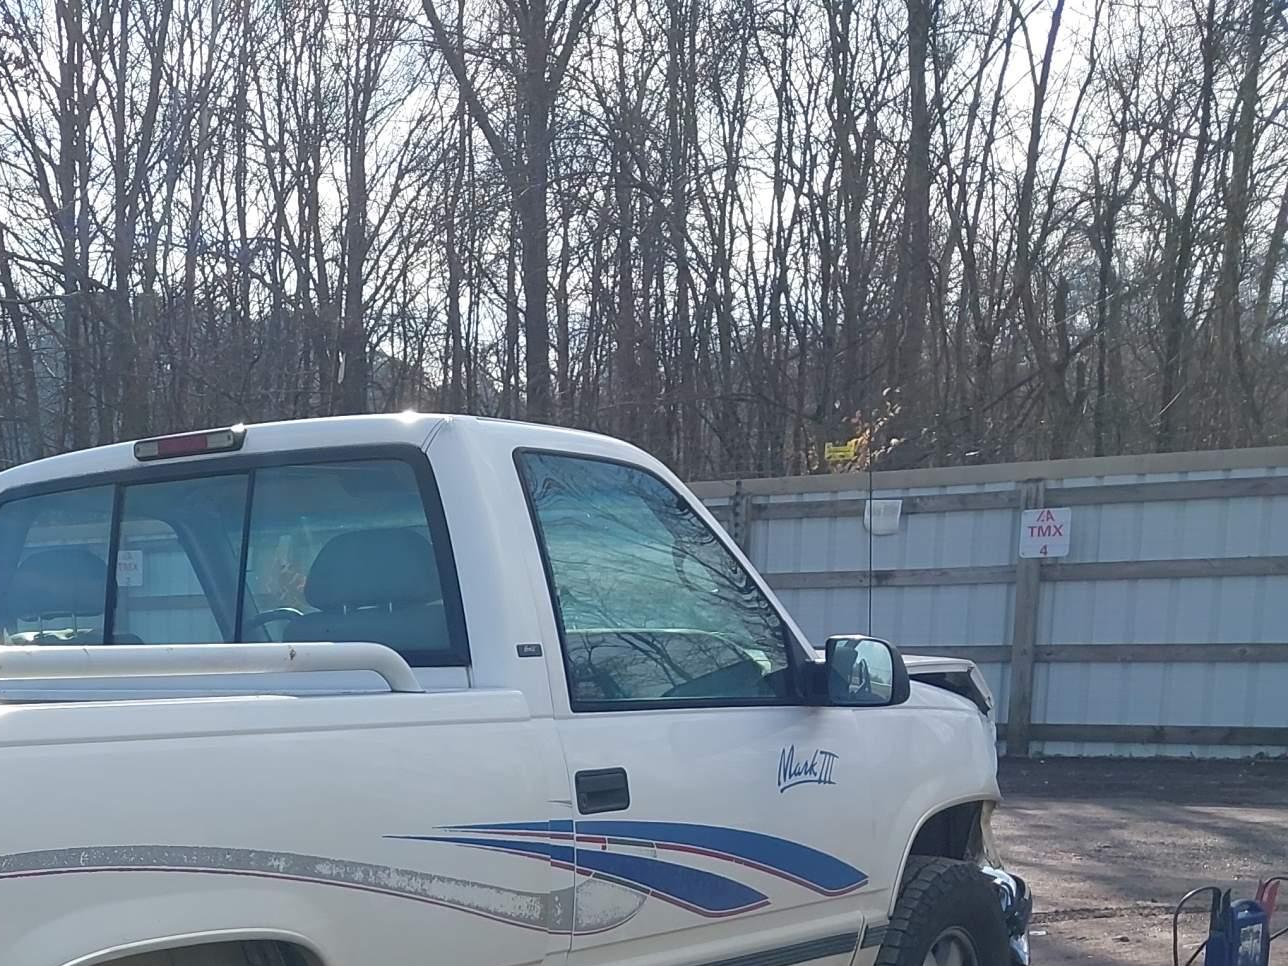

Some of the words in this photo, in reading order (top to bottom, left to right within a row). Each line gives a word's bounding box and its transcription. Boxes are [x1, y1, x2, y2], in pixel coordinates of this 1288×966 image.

[1027, 524, 1064, 537] TMX
[1039, 544, 1049, 556] 4
[777, 744, 819, 787] Mark
